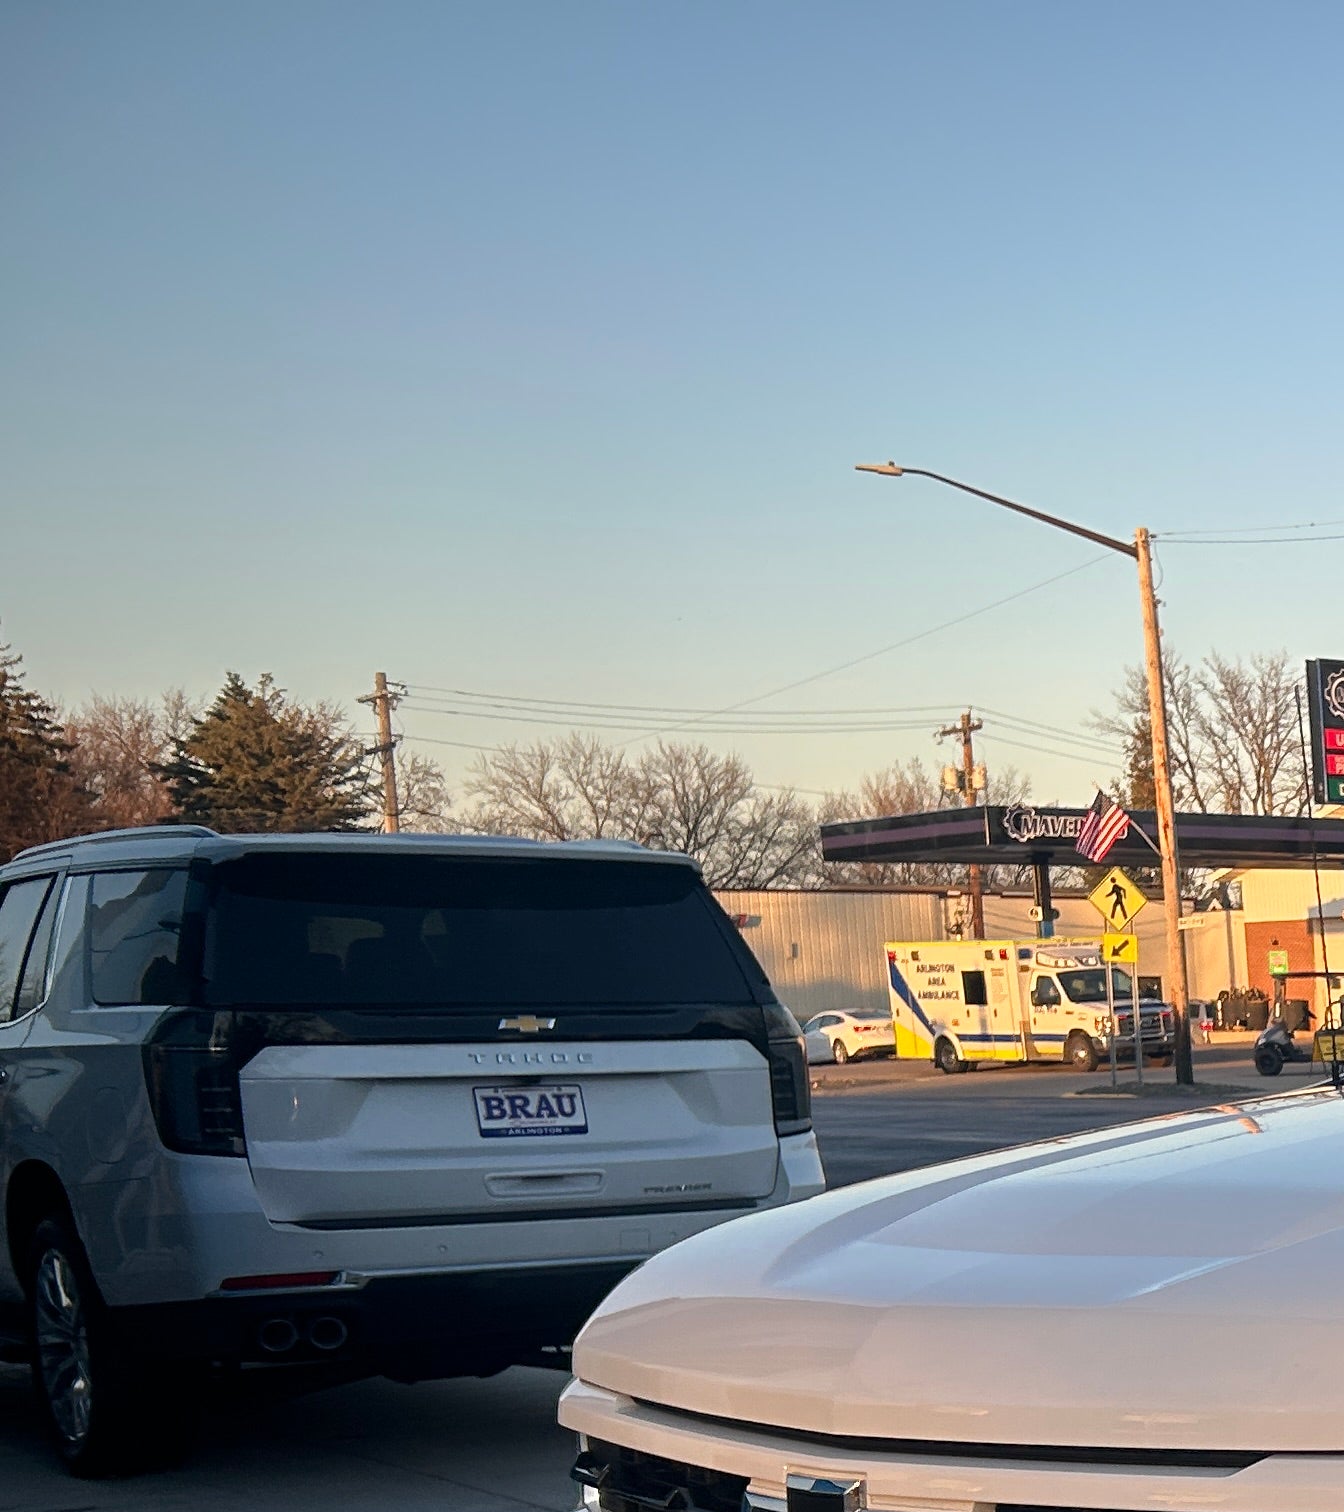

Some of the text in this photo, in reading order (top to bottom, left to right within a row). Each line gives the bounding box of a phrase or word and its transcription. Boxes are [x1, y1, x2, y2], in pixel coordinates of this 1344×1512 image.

[918, 990, 960, 1000] AMBULANCE
[468, 1052, 594, 1065] TAHOE
[480, 1093, 577, 1121] BRAU
